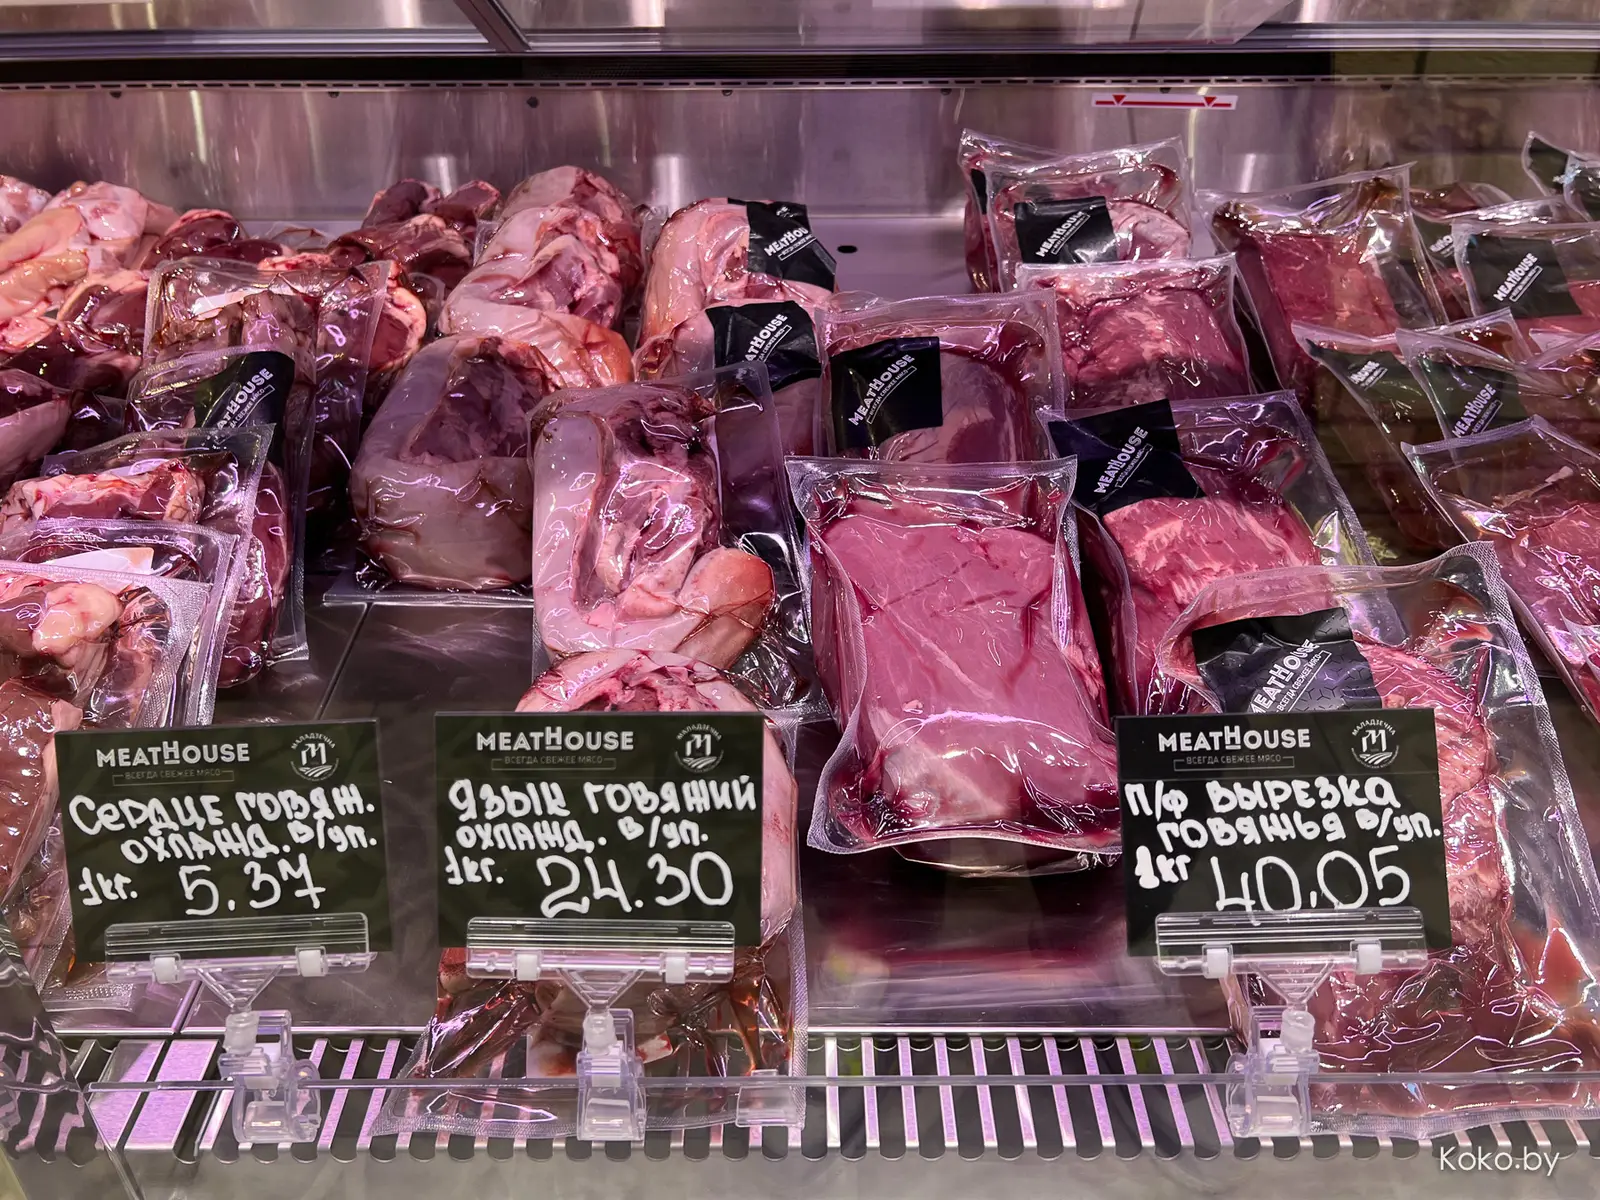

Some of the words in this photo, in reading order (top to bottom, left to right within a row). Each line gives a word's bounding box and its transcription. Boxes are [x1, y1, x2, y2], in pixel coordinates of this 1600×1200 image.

[1493, 252, 1538, 301] MEATHOUSE
[745, 313, 789, 361] ATHOUSE
[216, 367, 274, 429] ATHOUSE
[848, 354, 915, 426] MEATHOUSE
[1451, 383, 1497, 438] MEATHOUSE
[1093, 426, 1149, 494] MEATHOUSE
[1291, 664, 1312, 690] СВЕЖЕЕ
[96, 740, 250, 768] MEATHOUSE
[476, 726, 634, 751] MEATHOUSE
[504, 756, 539, 765] ВСЕГДА
[540, 755, 576, 764] СВЕЖЕЕ
[1158, 725, 1311, 752] MEATHOUSE
[1186, 756, 1219, 765] ВСЕГДА
[1220, 755, 1256, 764] СВЕЖЕЕ
[1257, 754, 1281, 763] МЯСО
[124, 771, 158, 780] ВСЕГДА
[160, 769, 196, 778] СВЕЖЕЕ
[179, 852, 326, 916] 5.37
[536, 851, 734, 918] 24.30
